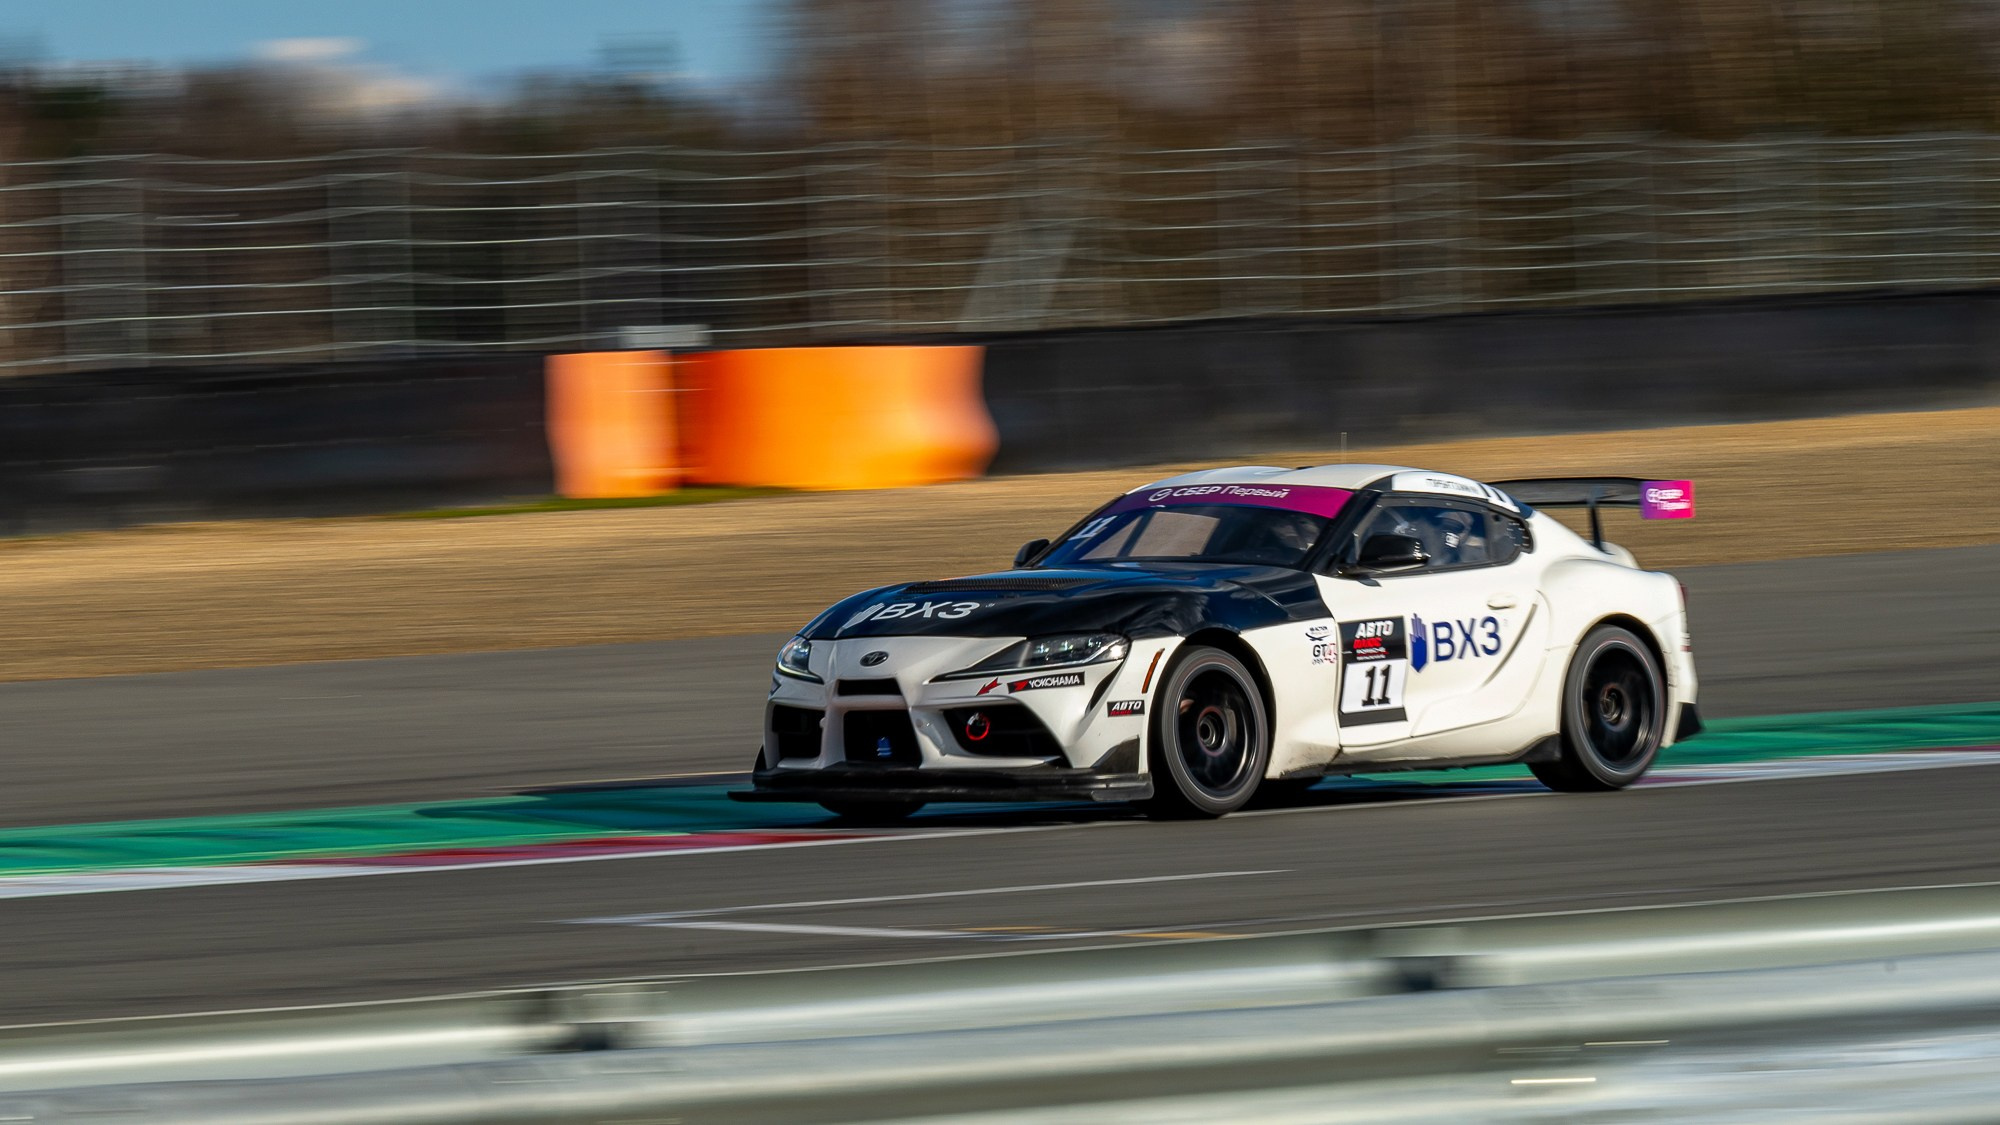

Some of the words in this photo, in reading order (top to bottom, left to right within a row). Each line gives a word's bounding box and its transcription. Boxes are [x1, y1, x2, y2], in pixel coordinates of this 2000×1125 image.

[1172, 486, 1222, 497] СБЕР
[1220, 485, 1291, 499] Первый
[869, 601, 981, 621] BX3
[1432, 616, 1502, 662] BX3
[1028, 674, 1081, 689] YOKOHAMA
[1361, 664, 1392, 706] 11
